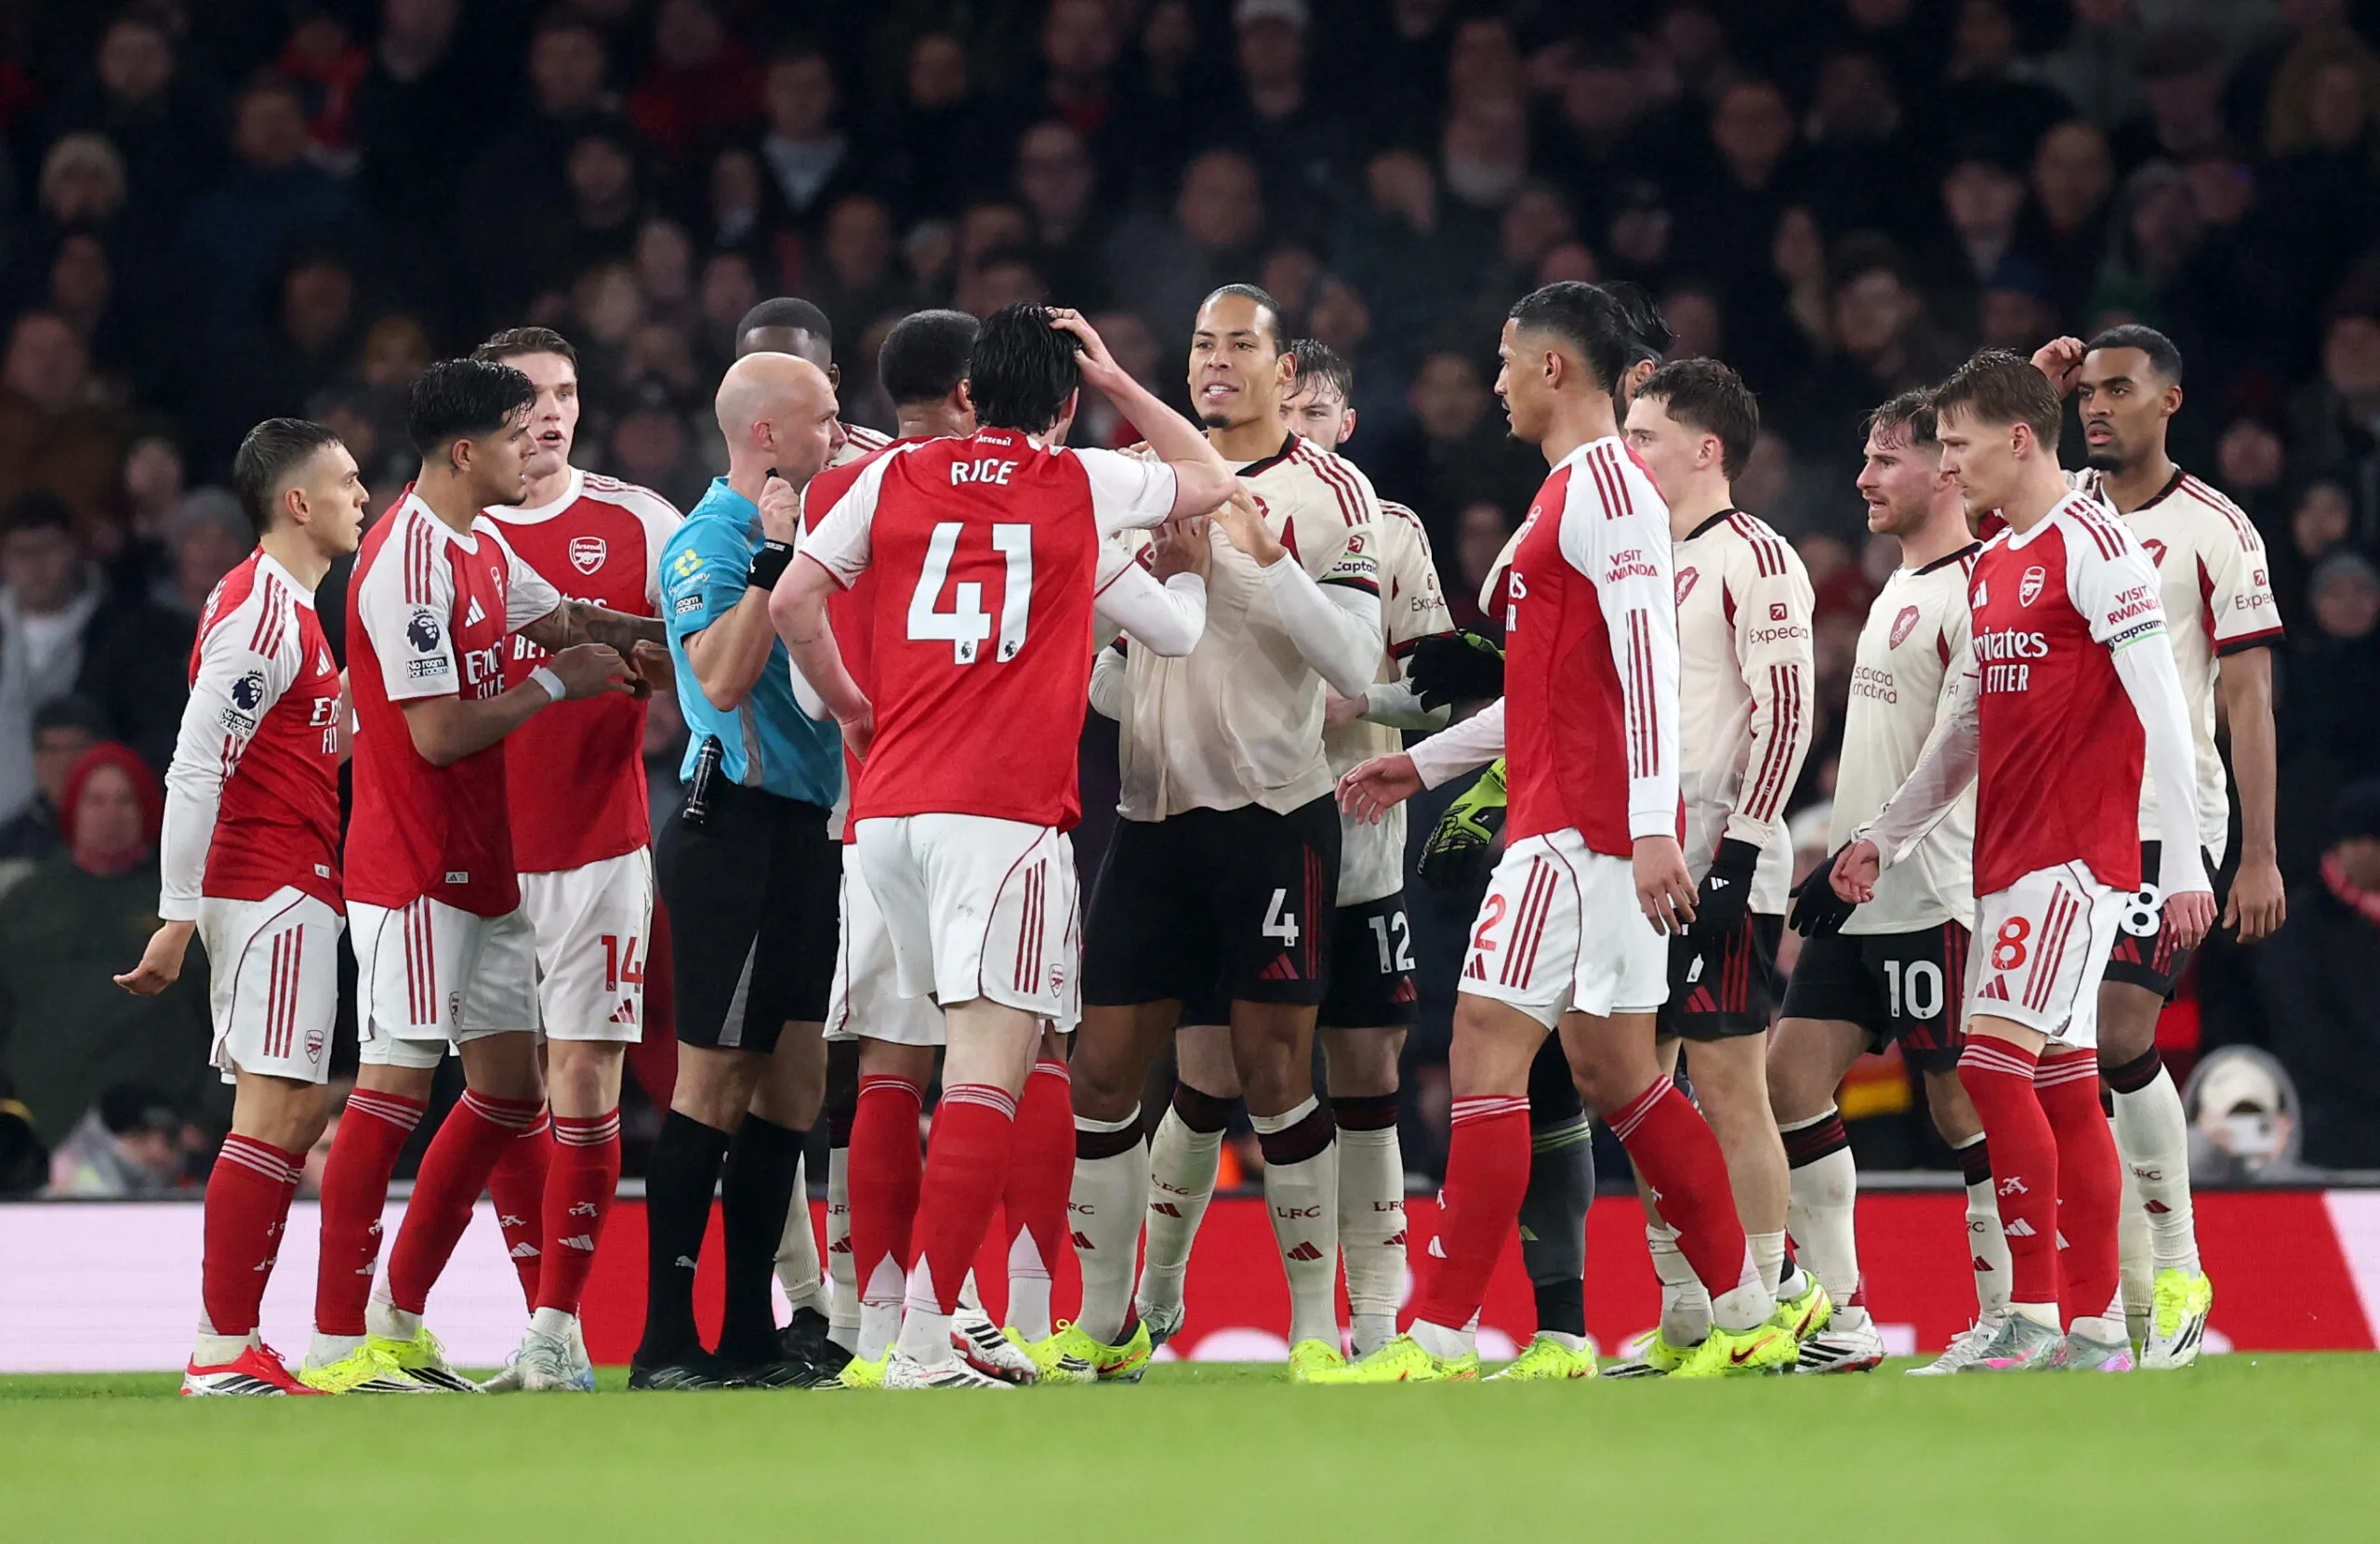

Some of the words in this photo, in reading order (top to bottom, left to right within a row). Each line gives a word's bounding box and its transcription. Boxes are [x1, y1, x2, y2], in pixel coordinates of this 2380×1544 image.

[975, 434, 1012, 446] Arsenal
[951, 458, 1019, 485] RICE
[1610, 549, 1642, 566] VISIT
[907, 522, 1033, 665] 41
[2115, 586, 2148, 604] VISIT
[422, 659, 444, 668] room
[1263, 889, 1299, 946] 4
[1368, 911, 1416, 974] 12
[1474, 894, 1505, 952] 2
[1991, 916, 2030, 970] 8
[602, 935, 644, 994] 14
[1884, 960, 1943, 1019] 10
[1276, 1206, 1320, 1220] LFC
